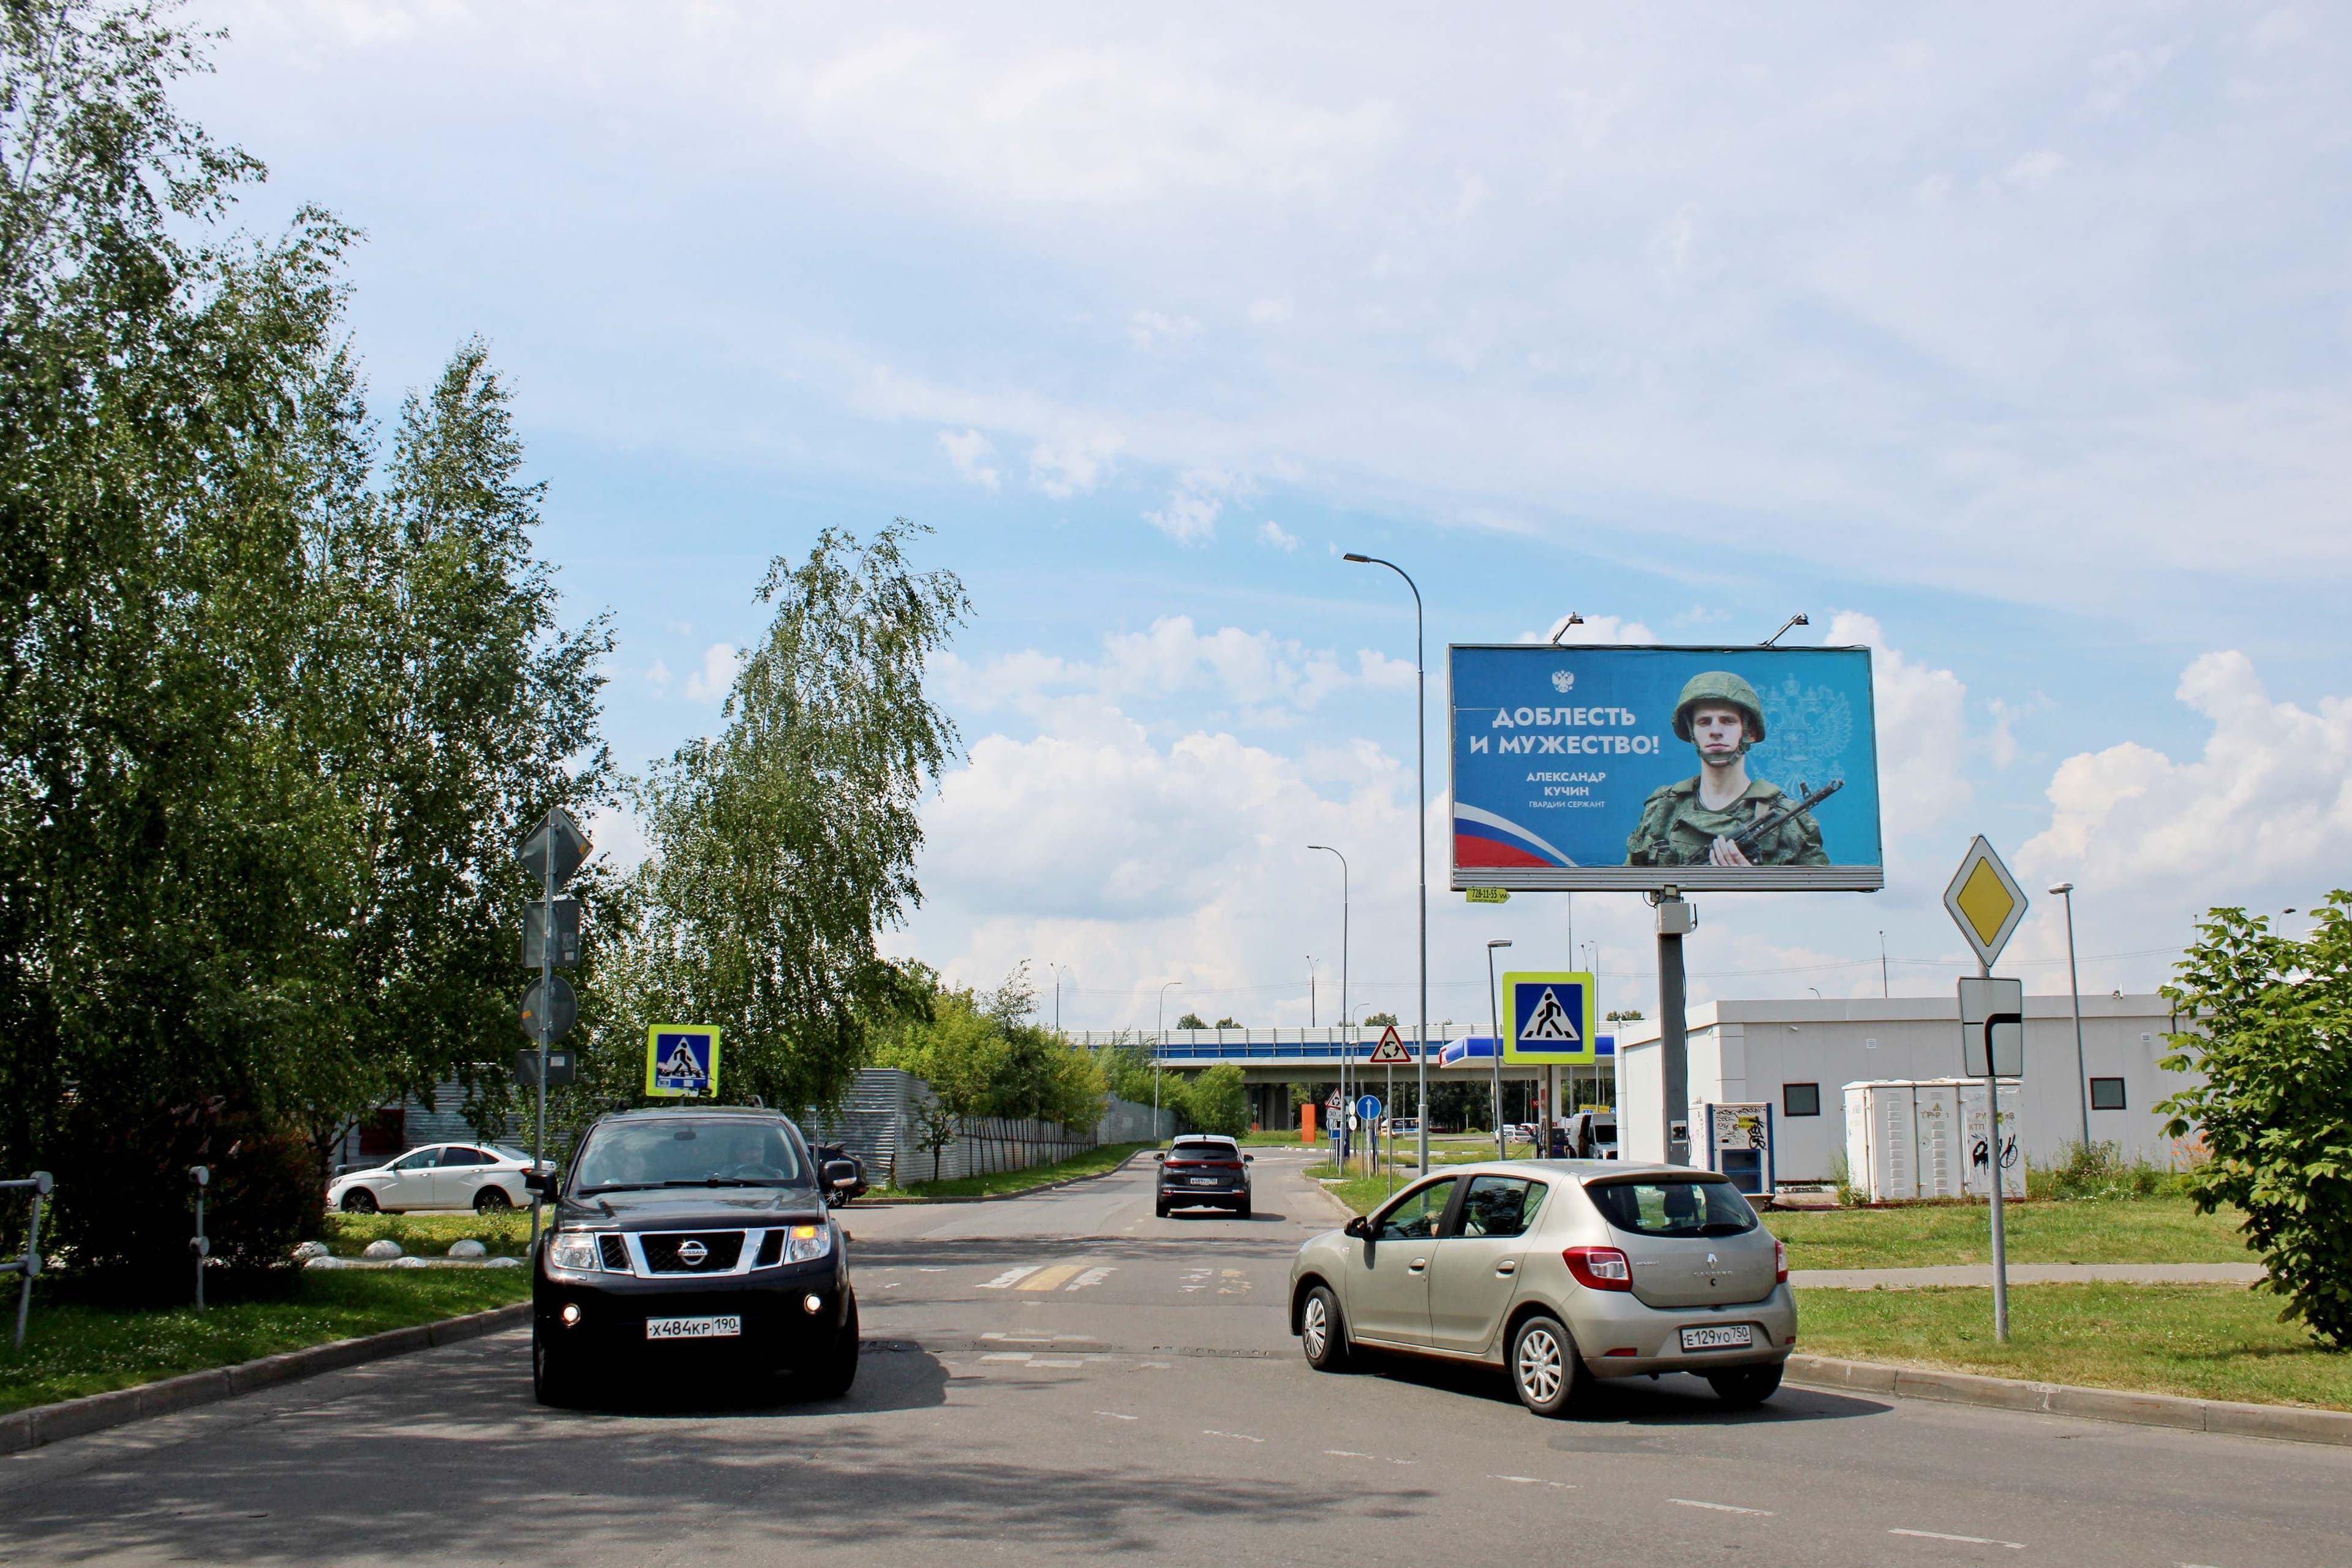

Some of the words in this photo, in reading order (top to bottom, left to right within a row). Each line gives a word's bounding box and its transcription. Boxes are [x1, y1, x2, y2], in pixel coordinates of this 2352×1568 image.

[1492, 707, 1636, 728] ДОБЛЕСТЬ
[1470, 736, 1488, 754] И
[1499, 736, 1659, 754] МУЖЕСТВО!
[1526, 772, 1607, 783] АЛЕКСАНДР
[1544, 786, 1589, 796] КУЧИН
[1472, 889, 1497, 899] 728-11-55
[714, 1318, 736, 1330] 190
[1731, 1327, 1747, 1338] 750
